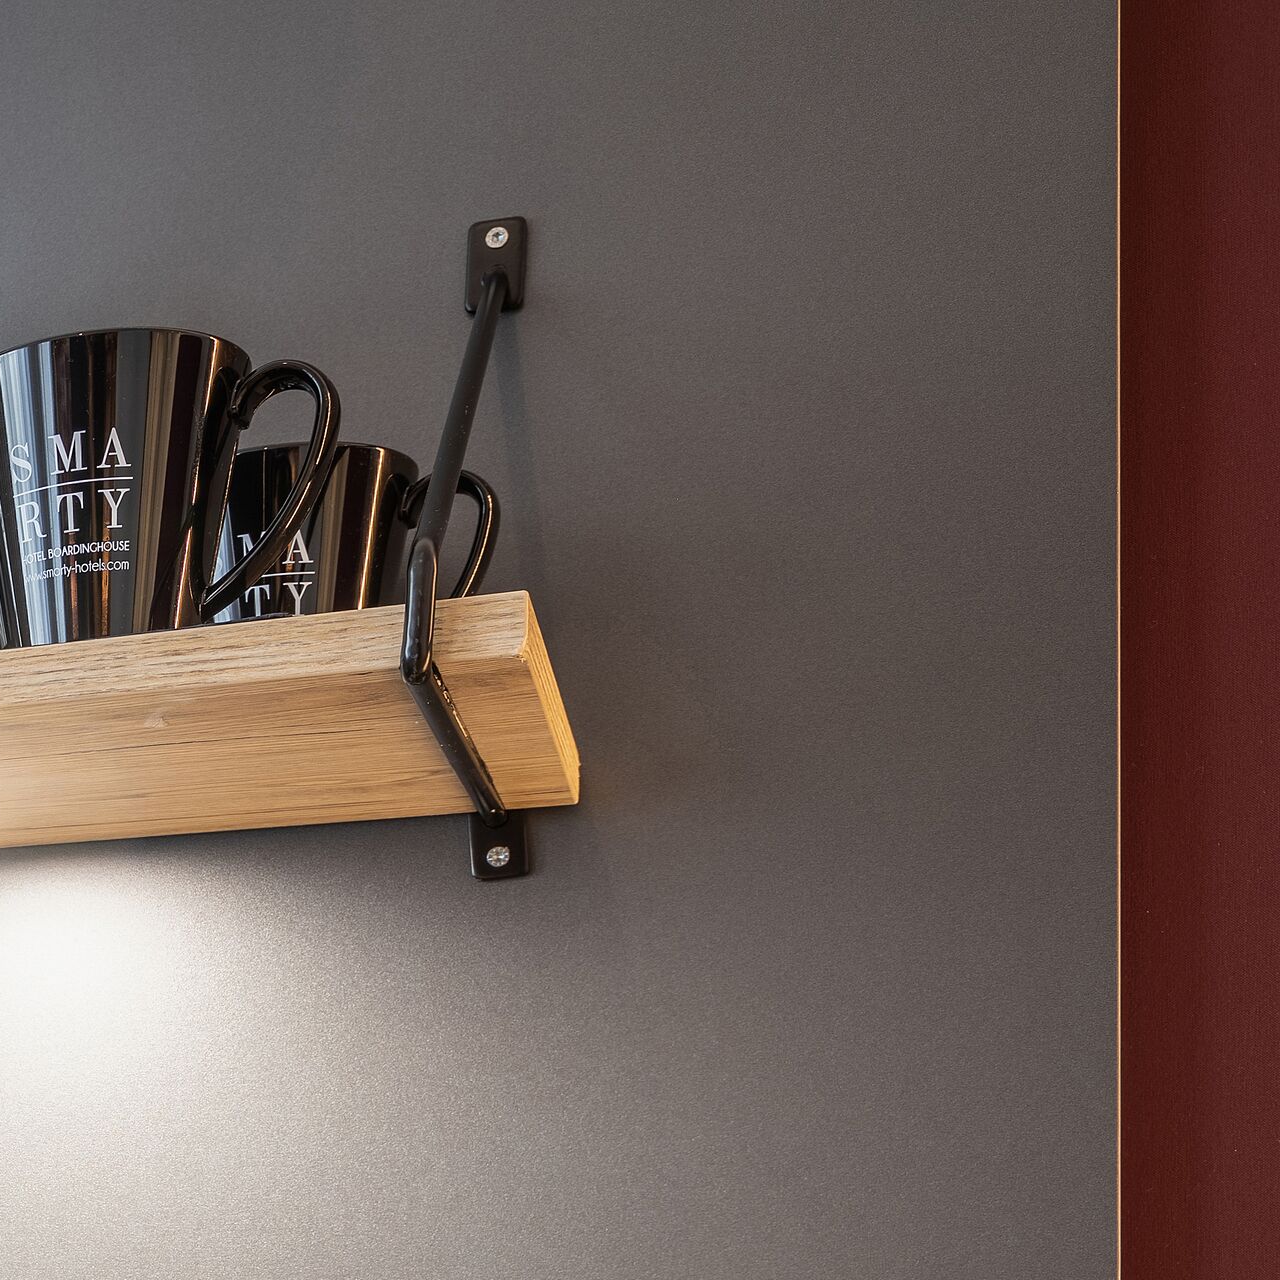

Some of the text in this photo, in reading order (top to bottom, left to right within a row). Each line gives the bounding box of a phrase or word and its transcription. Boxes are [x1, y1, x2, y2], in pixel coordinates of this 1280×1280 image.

[10, 427, 132, 484] SMA
[16, 488, 131, 544] RTY
[22, 541, 130, 566] HOTEL BOARDINGHOUSE
